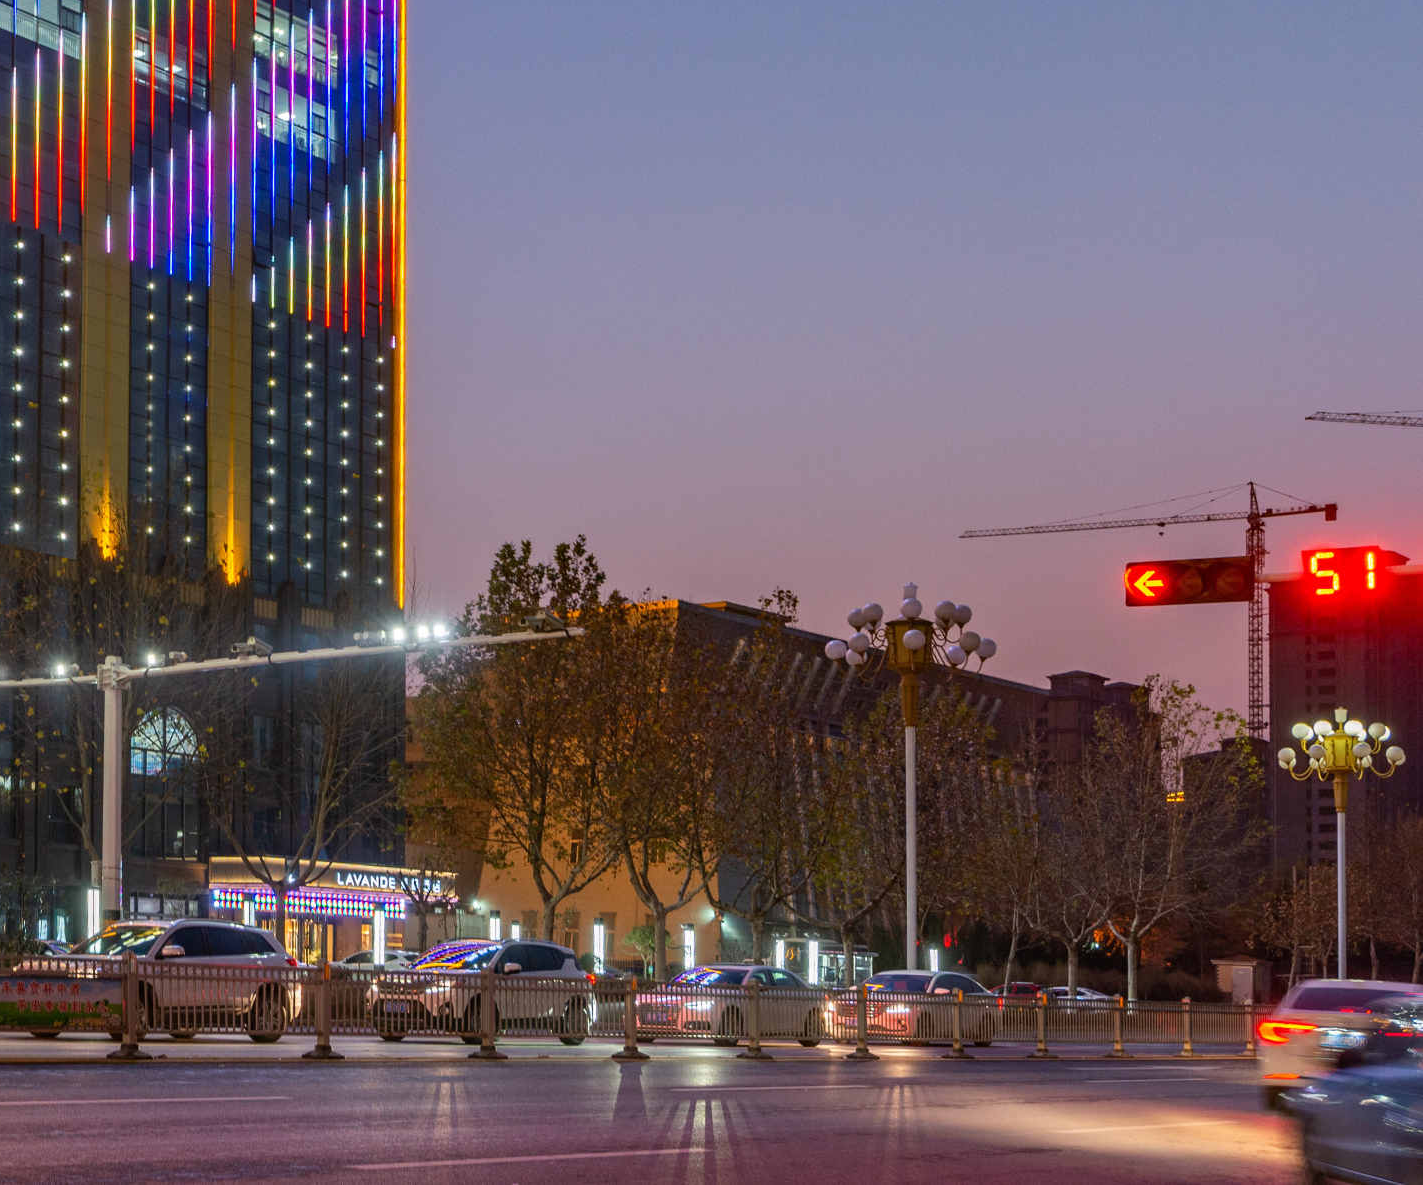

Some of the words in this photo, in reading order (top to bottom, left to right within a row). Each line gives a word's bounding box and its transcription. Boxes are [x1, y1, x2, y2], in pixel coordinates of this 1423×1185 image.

[1311, 551, 1375, 595] 51
[336, 871, 396, 890] LAVANDE
[16, 999, 108, 1013] 平安幸福到永久
